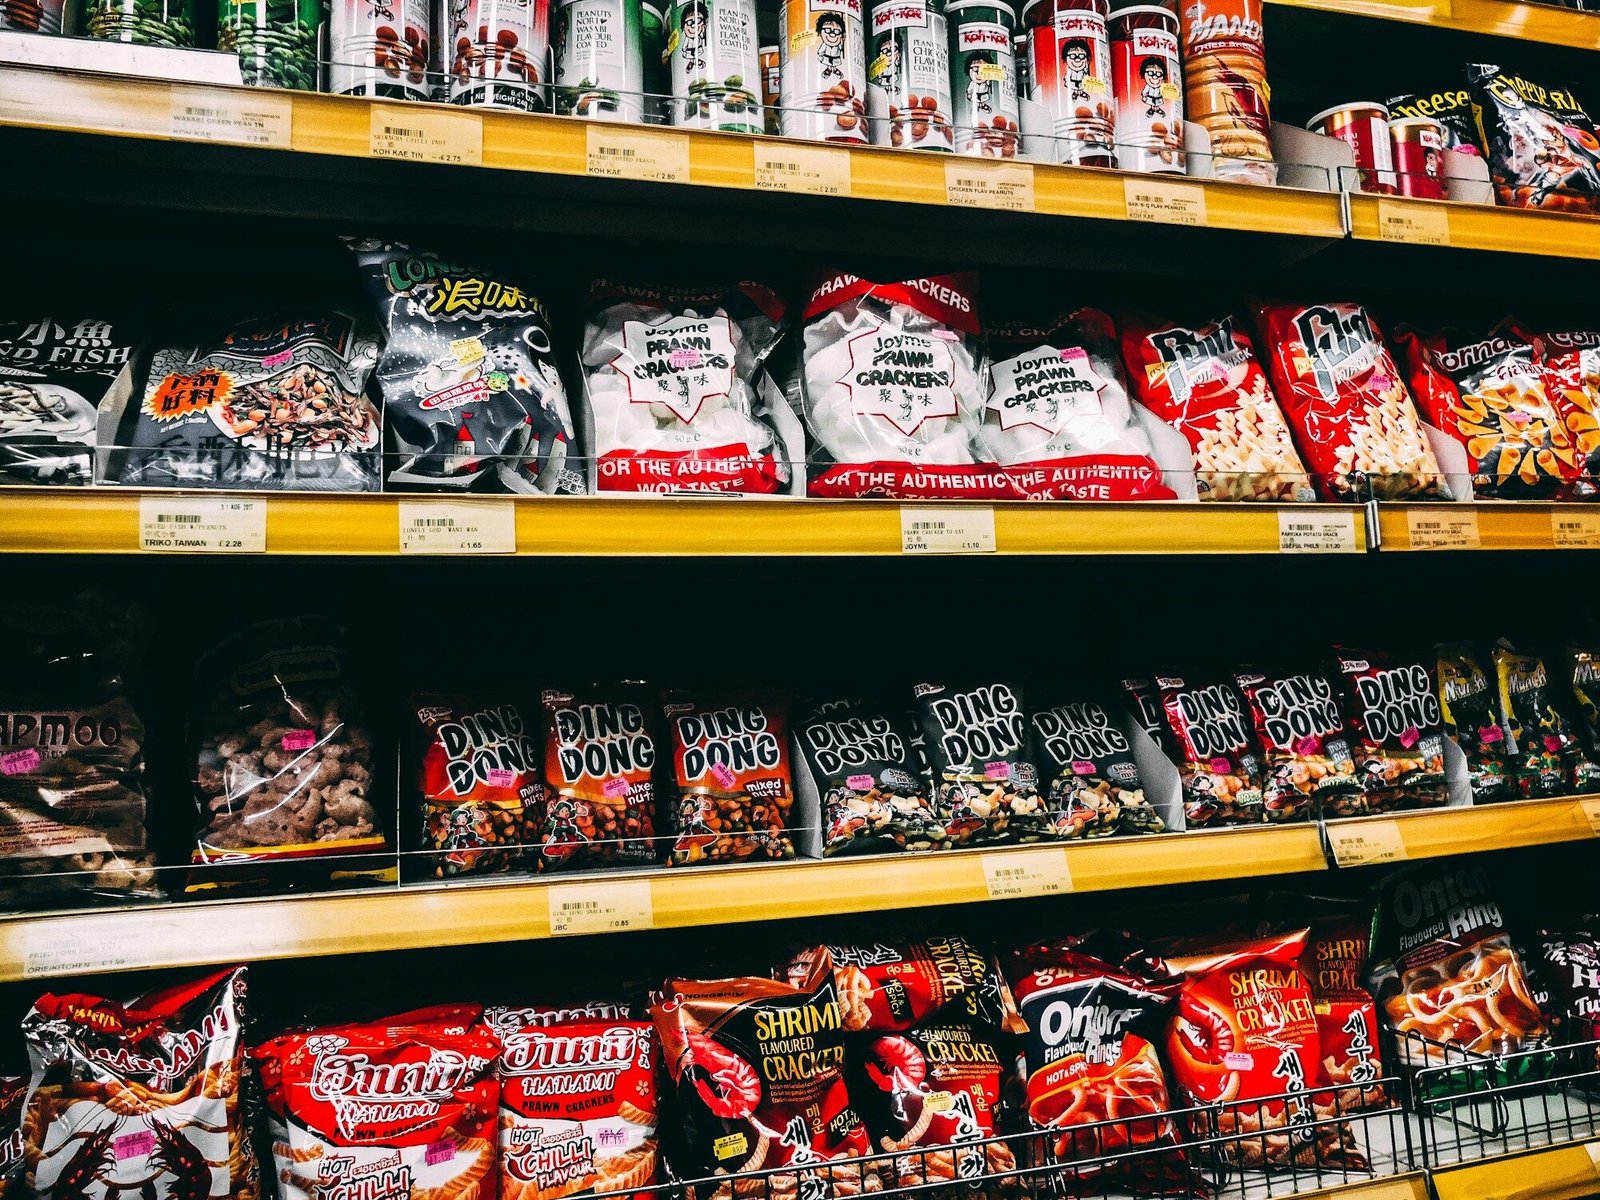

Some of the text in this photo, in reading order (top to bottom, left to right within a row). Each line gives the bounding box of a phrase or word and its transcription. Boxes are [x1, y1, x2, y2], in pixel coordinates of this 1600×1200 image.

[576, 10, 612, 18] PEANUTS
[392, 149, 408, 157] KAE
[588, 167, 605, 175] KOH
[645, 323, 709, 337] Joyme
[50, 346, 132, 365] FISH
[872, 350, 934, 369] PRAWN
[855, 369, 949, 389] CRACKERS
[1015, 367, 1076, 392] PRAWN
[1003, 379, 1095, 410] CRACKERS
[640, 460, 673, 477] THE
[856, 472, 1007, 489] THE AUTHENTIC
[1051, 466, 1153, 483] AUTHENTIC
[1059, 482, 1111, 499] TASTE
[1255, 675, 1331, 718] DING
[1358, 665, 1430, 710] DING
[932, 683, 1018, 733] DING
[1177, 684, 1240, 725] DING
[1363, 693, 1441, 743] DONG
[438, 703, 523, 760] DING
[555, 703, 644, 748] DING
[676, 706, 768, 748] DING
[806, 715, 890, 751] DING
[1032, 703, 1108, 738] DING
[1265, 700, 1343, 749] DONG
[558, 734, 656, 784] DONG
[683, 732, 781, 782] DONG
[815, 732, 905, 776] DONG
[1045, 728, 1130, 765] DONG
[446, 736, 537, 796] DONG
[746, 778, 782, 791] mixed
[751, 788, 782, 798] nuts
[1400, 901, 1503, 951] Flavoured Ring
[685, 991, 745, 1000] NONGSHIM
[885, 986, 902, 1016] SPICY
[759, 1036, 814, 1055] FLAVOURED
[1086, 1040, 1123, 1067] Rings
[521, 1072, 616, 1096] HANAMI
[522, 1093, 616, 1113] PRAWN CRACKERS
[512, 1129, 543, 1144] HOT
[320, 1158, 353, 1177] HOT
[523, 1138, 593, 1174] CHILLI
[330, 1166, 410, 1200] CHILLI
[537, 1161, 595, 1191] FLAVOUR
